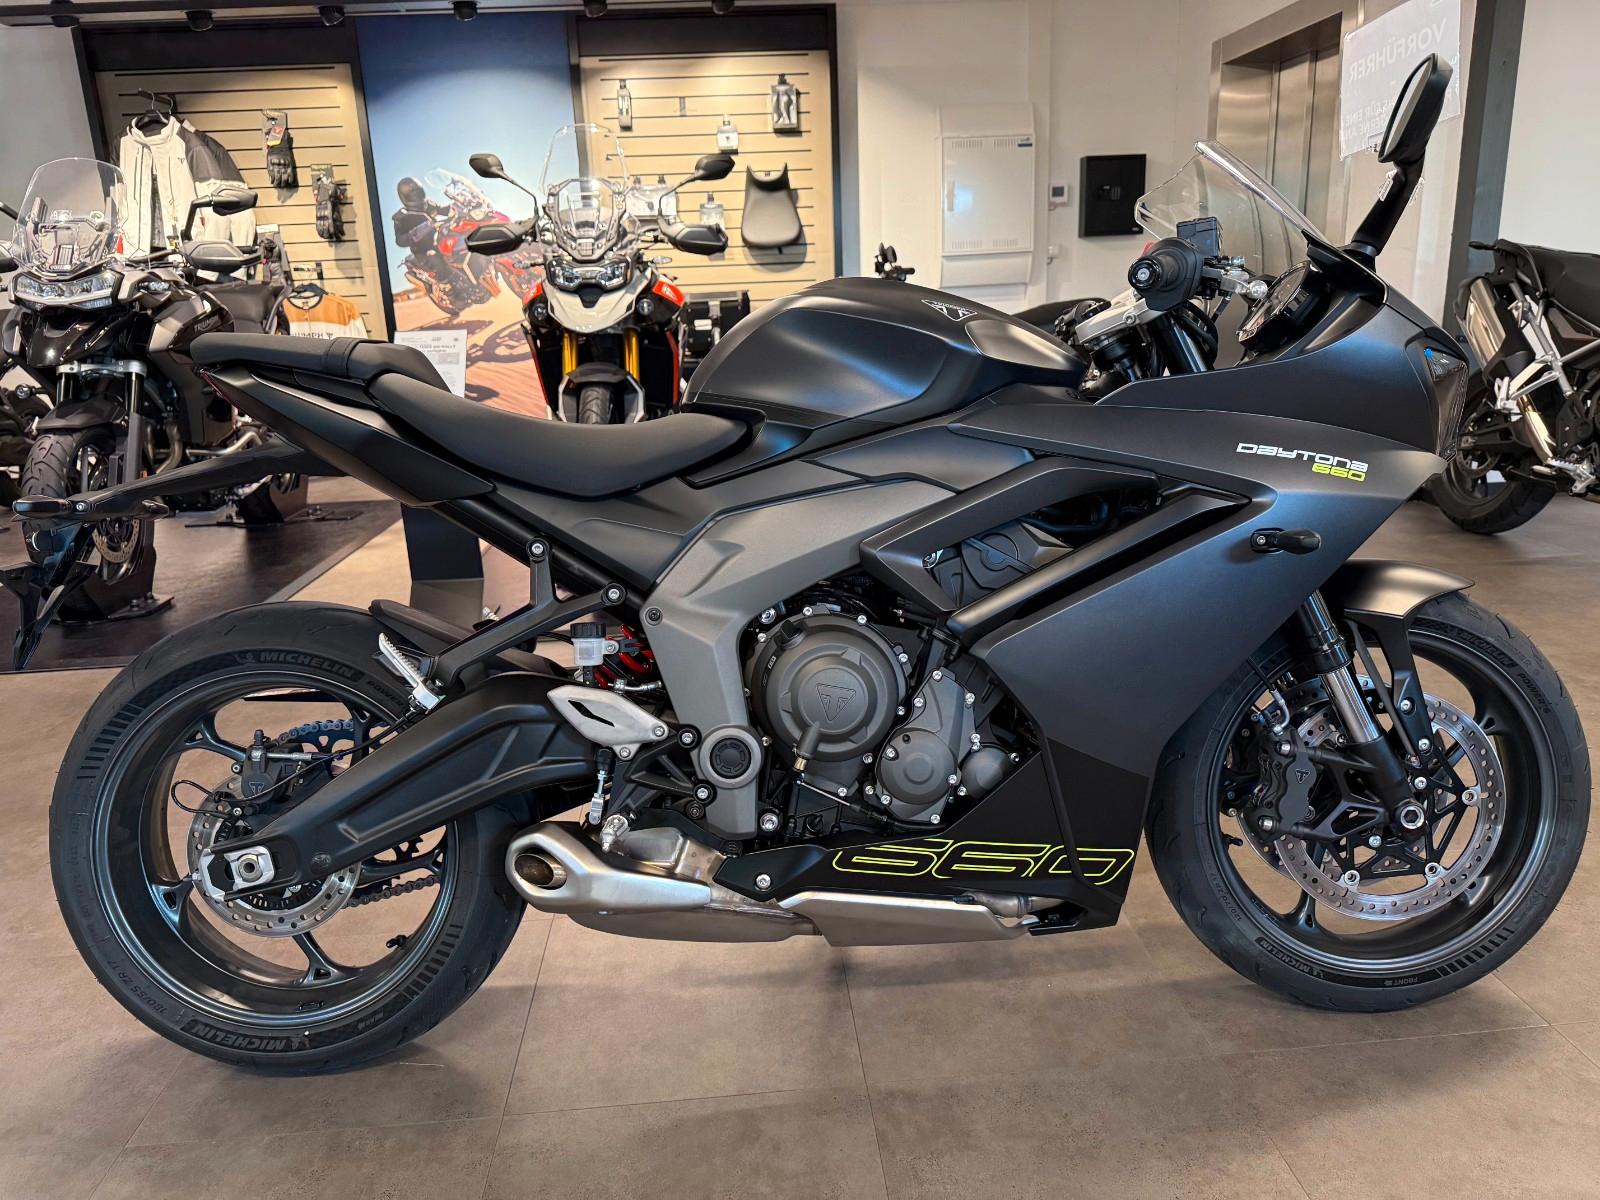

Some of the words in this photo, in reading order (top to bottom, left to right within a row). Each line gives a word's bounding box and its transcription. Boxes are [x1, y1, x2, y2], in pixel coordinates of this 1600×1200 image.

[1311, 463, 1366, 481] 660
[1459, 630, 1513, 668] MICHELIN
[259, 651, 355, 682] MICHELIN
[832, 838, 1135, 885] 660
[107, 960, 120, 970] 17
[1260, 938, 1311, 974] MICHELIN
[118, 972, 133, 984] ZR
[1393, 976, 1418, 986] FRONT
[130, 985, 167, 1013] 180/55
[191, 1022, 287, 1051] MICHELIN
